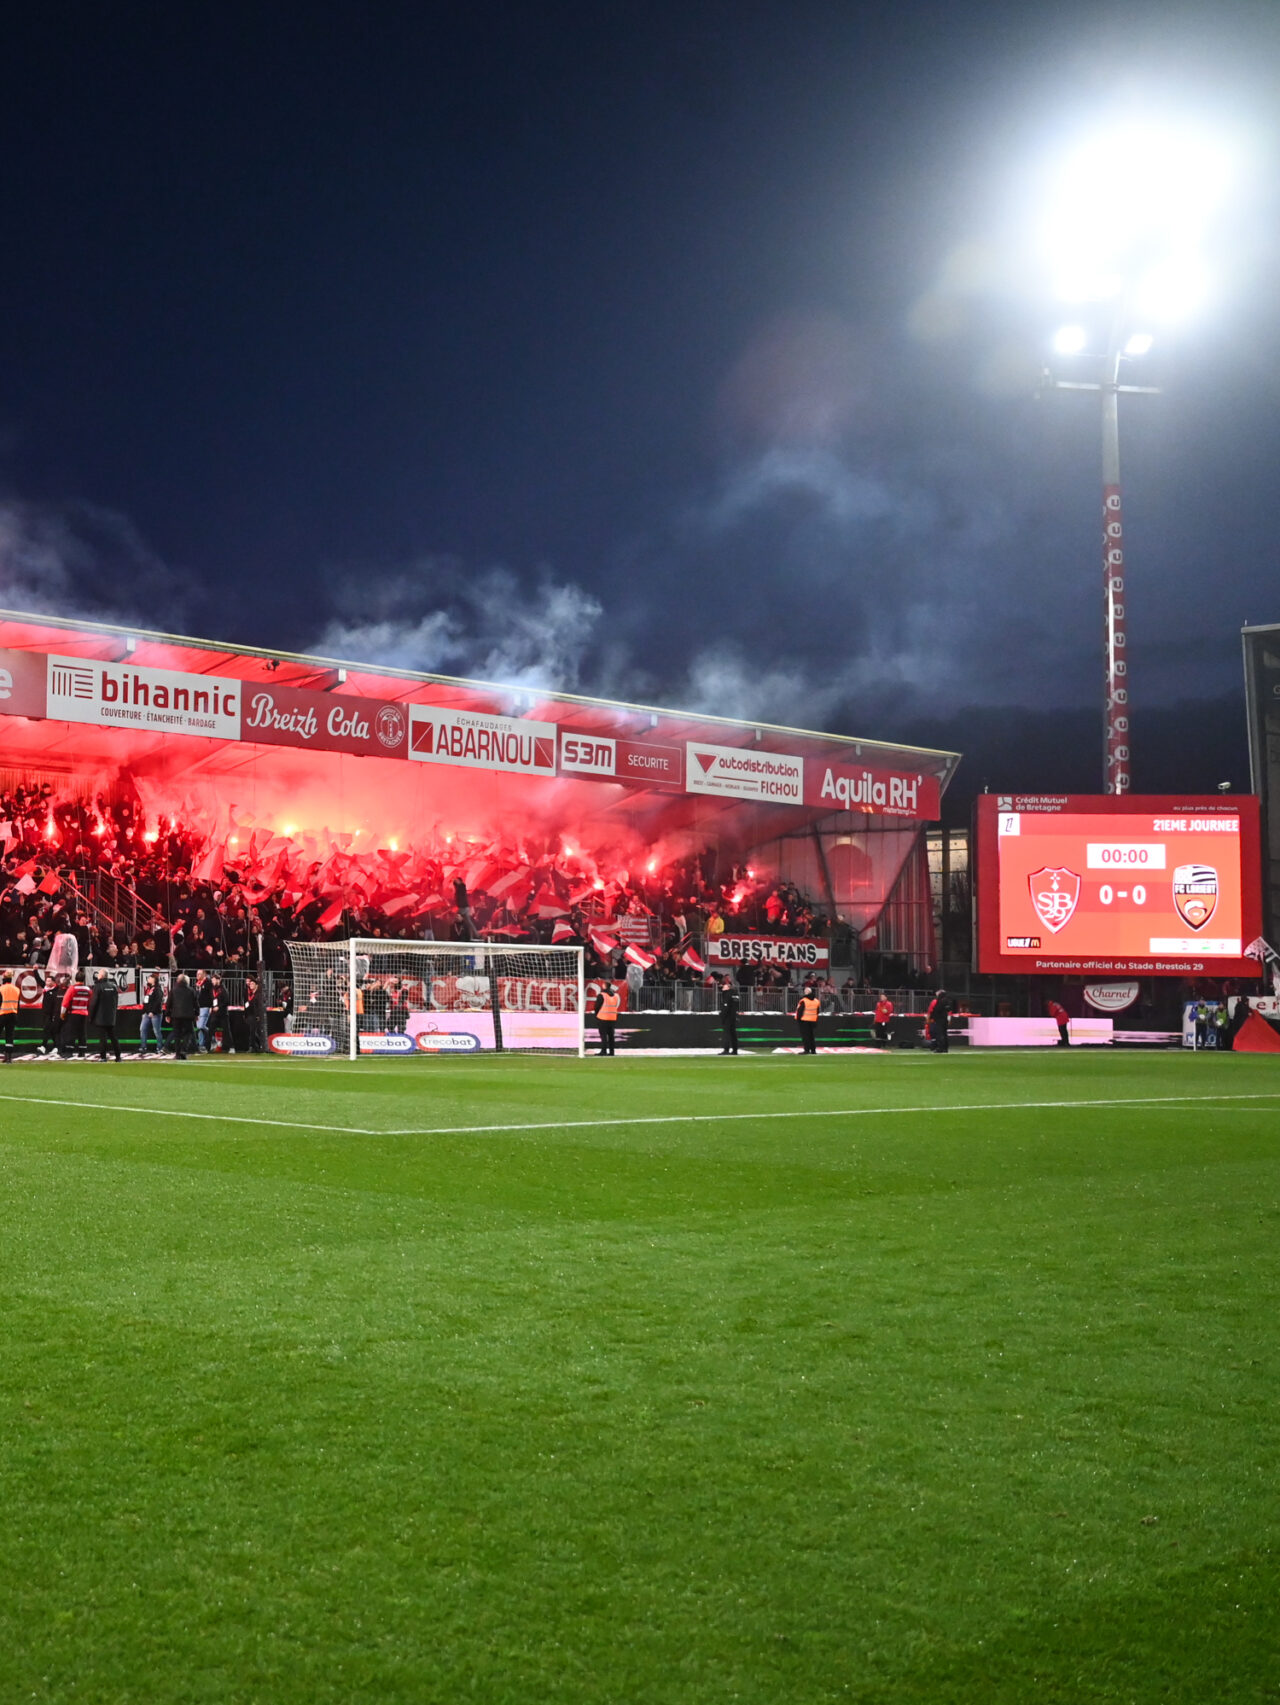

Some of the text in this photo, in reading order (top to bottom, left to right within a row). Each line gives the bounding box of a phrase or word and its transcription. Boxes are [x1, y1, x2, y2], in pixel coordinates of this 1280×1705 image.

[101, 669, 236, 717] bihannic
[100, 706, 142, 720] COUVERTURE
[188, 717, 217, 729] BARDAGE
[246, 692, 371, 740] Breizh Cola
[435, 723, 533, 766] ABARNOU
[627, 754, 670, 771] SECURITE
[718, 756, 800, 778] autodistribution
[760, 780, 799, 798] FICHOU
[820, 767, 887, 811] Aquila
[1015, 796, 1068, 804] Crédit Mutuel
[1026, 804, 1062, 813] Bretagne
[1153, 819, 1239, 832] 21EME JOURNEE
[1101, 849, 1148, 863] 00:00
[1099, 884, 1113, 905] 0
[1132, 884, 1146, 905] 0
[1043, 908, 1066, 921] 29
[719, 939, 817, 963] BREST FANS
[1036, 960, 1204, 971] Partenaire officiel du Stade Brestois 29
[1092, 986, 1132, 999] Charnel
[275, 1039, 327, 1047] trecobat
[423, 1037, 472, 1046] trecobat
